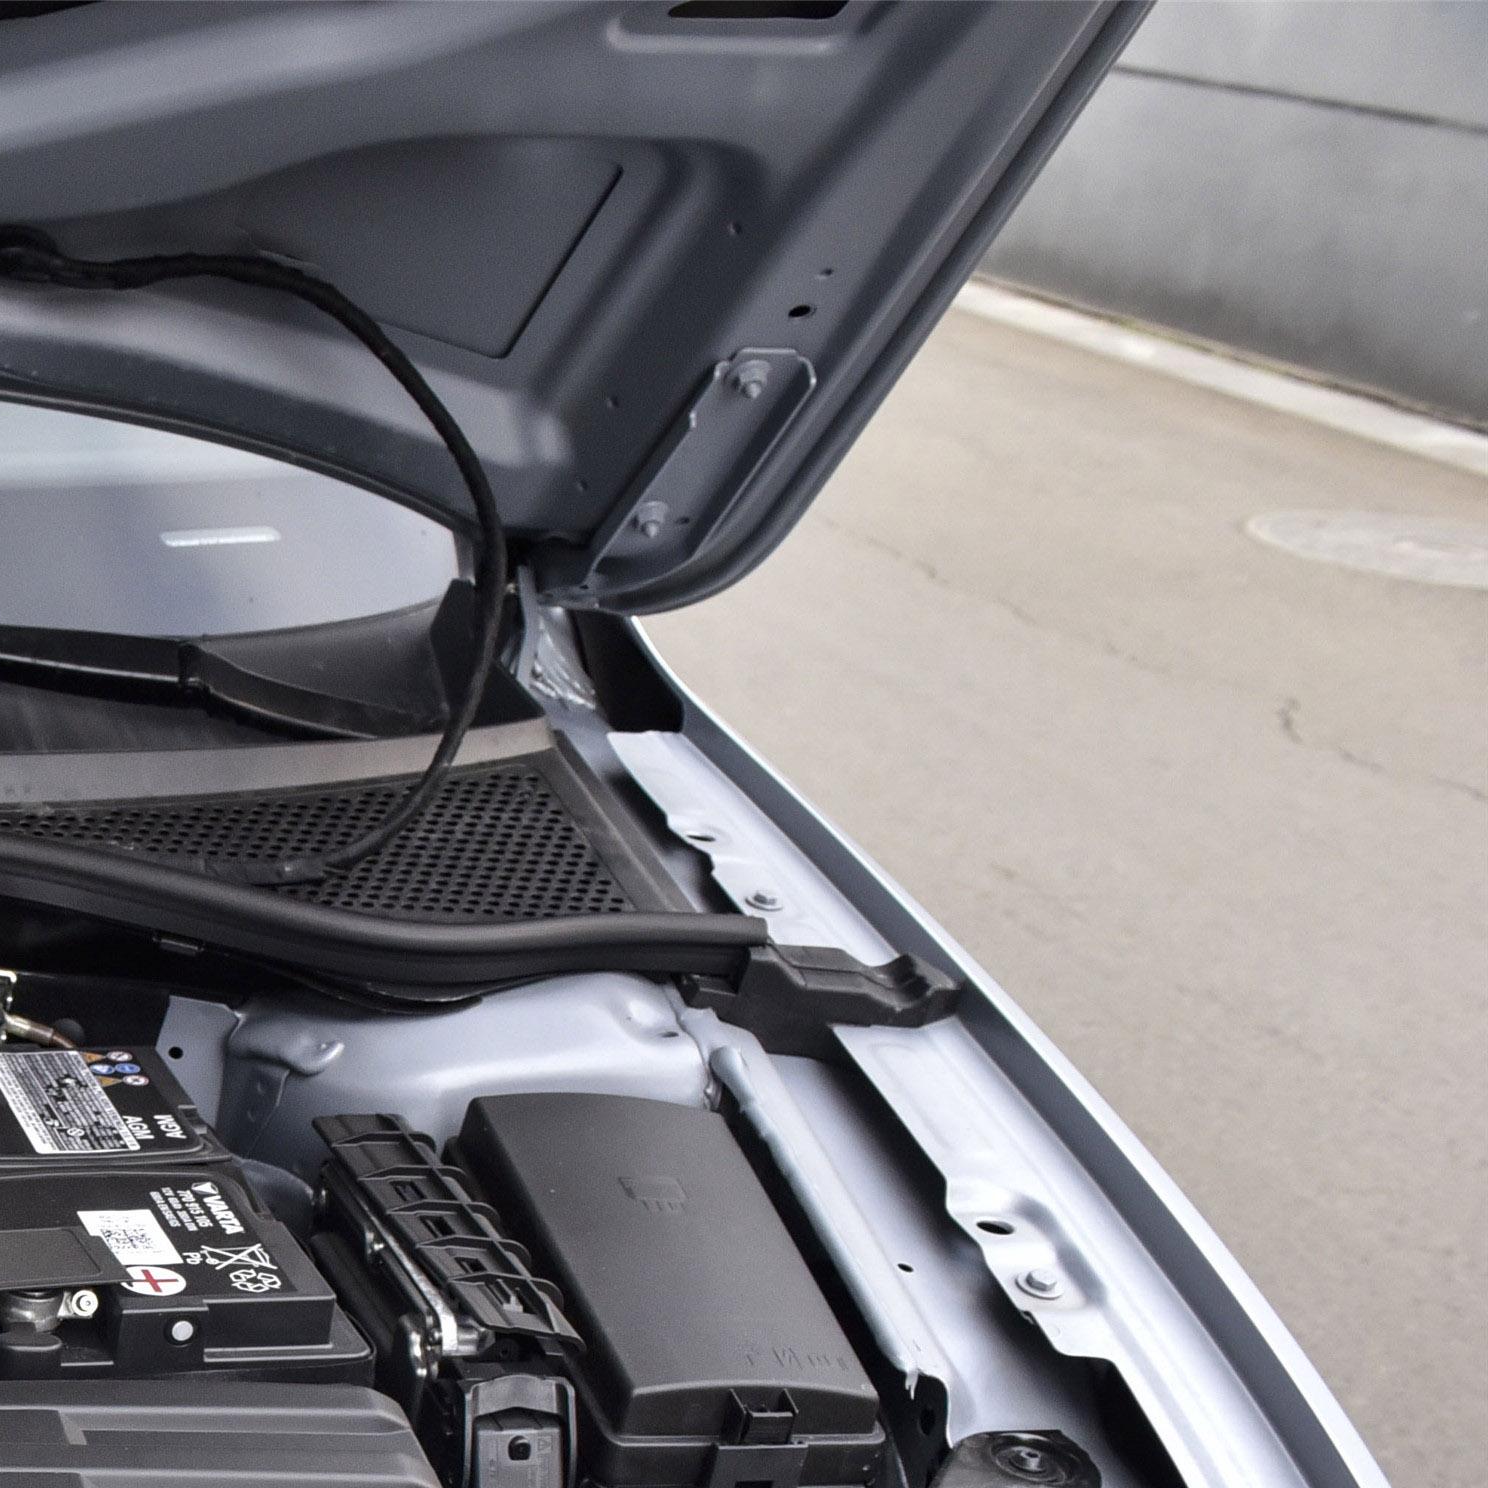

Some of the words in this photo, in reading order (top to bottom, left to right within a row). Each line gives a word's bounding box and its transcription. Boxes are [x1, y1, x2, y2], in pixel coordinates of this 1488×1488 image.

[122, 1115, 155, 1139] AGM
[153, 1114, 187, 1139] AGM
[203, 1195, 245, 1234] VARTA
[182, 1252, 204, 1265] Pb
